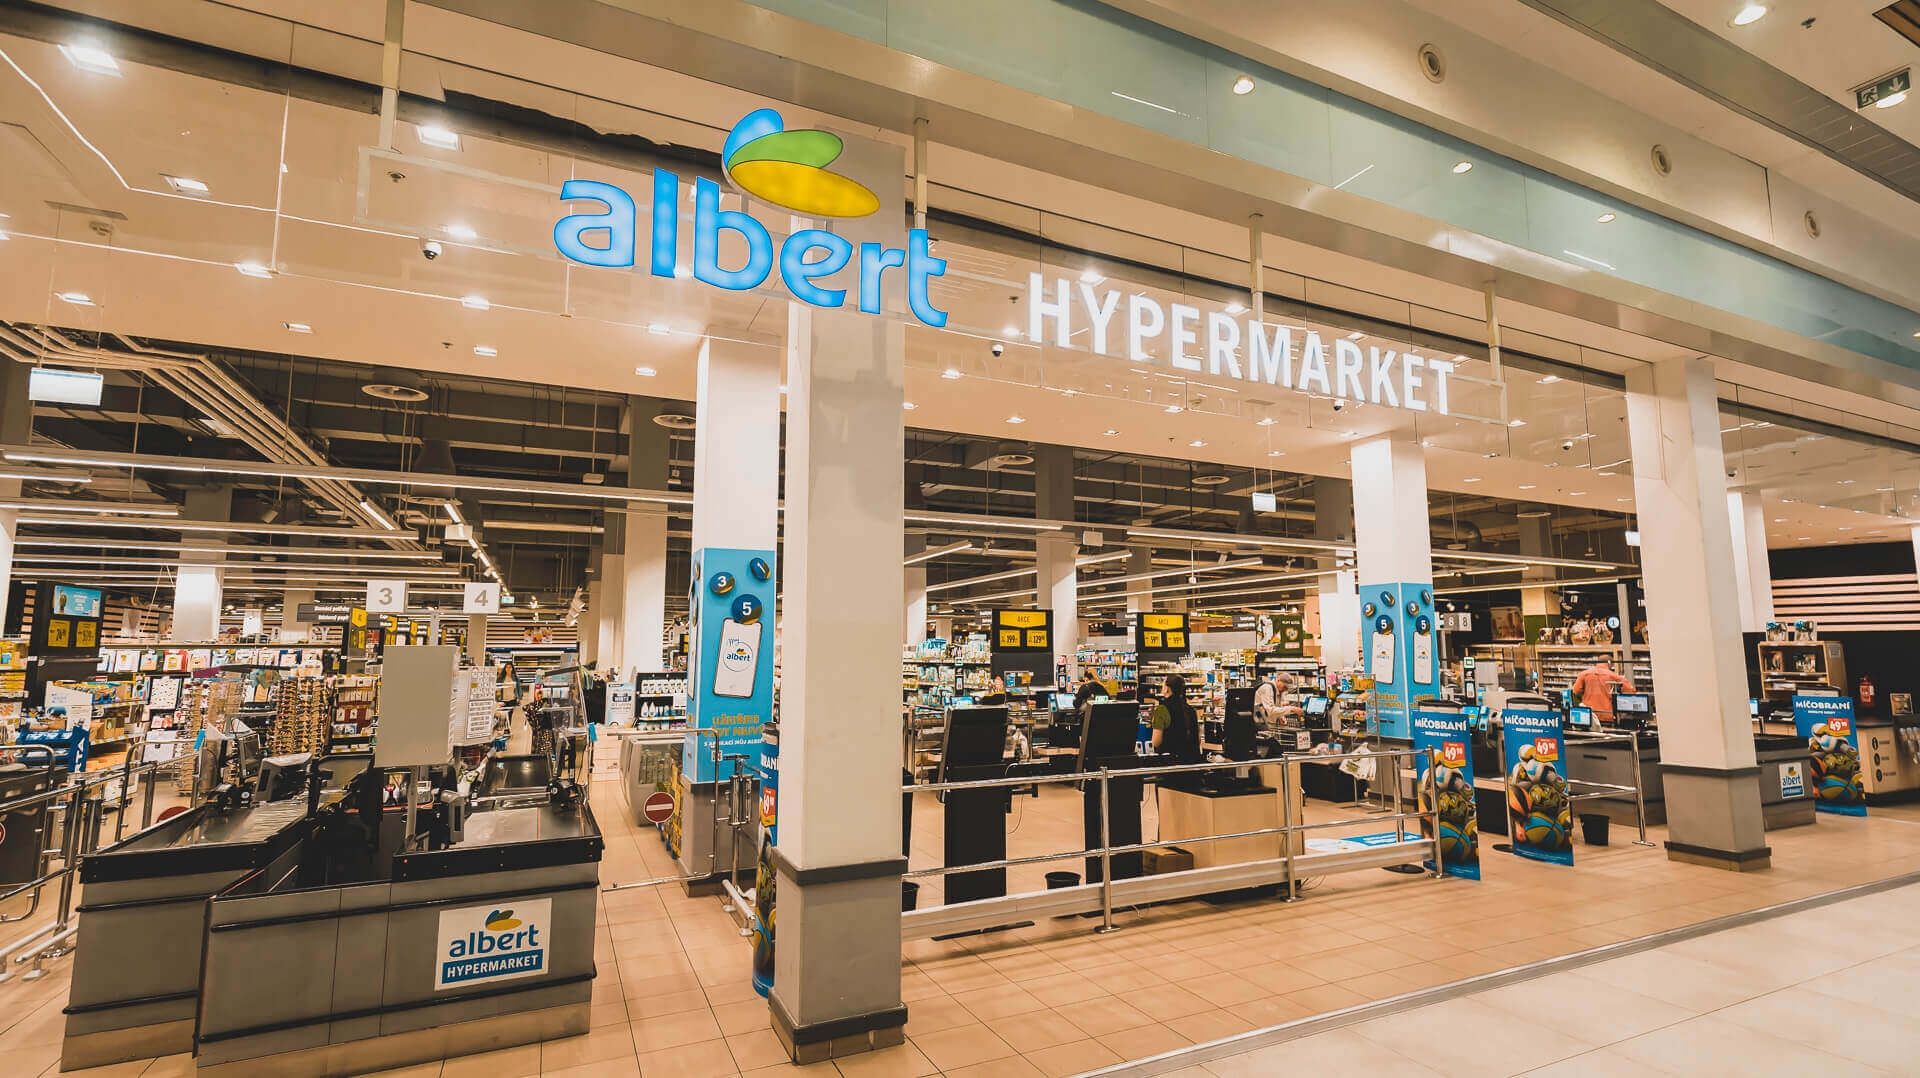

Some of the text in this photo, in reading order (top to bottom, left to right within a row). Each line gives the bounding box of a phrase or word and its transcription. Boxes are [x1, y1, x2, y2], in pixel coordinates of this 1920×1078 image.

[553, 167, 949, 328] albert
[1028, 272, 1455, 415] HYPERMARKET
[717, 576, 727, 588] 3
[379, 587, 393, 605] 3
[474, 589, 489, 607] 4
[742, 601, 752, 616] 5
[1381, 619, 1388, 629] 5
[1421, 619, 1427, 630] 5
[726, 651, 751, 662] albert
[1796, 700, 1851, 710] MÍČOBRANÍ
[1414, 717, 1467, 731] MÍČOBRANÍ
[1504, 714, 1559, 728] MÍČOBRANÍ
[1829, 720, 1841, 731] 49
[1445, 746, 1457, 761] 49
[1536, 741, 1549, 755] 49
[1782, 775, 1802, 786] albert
[448, 924, 540, 958] albert
[447, 954, 539, 978] HYPERMARKET
